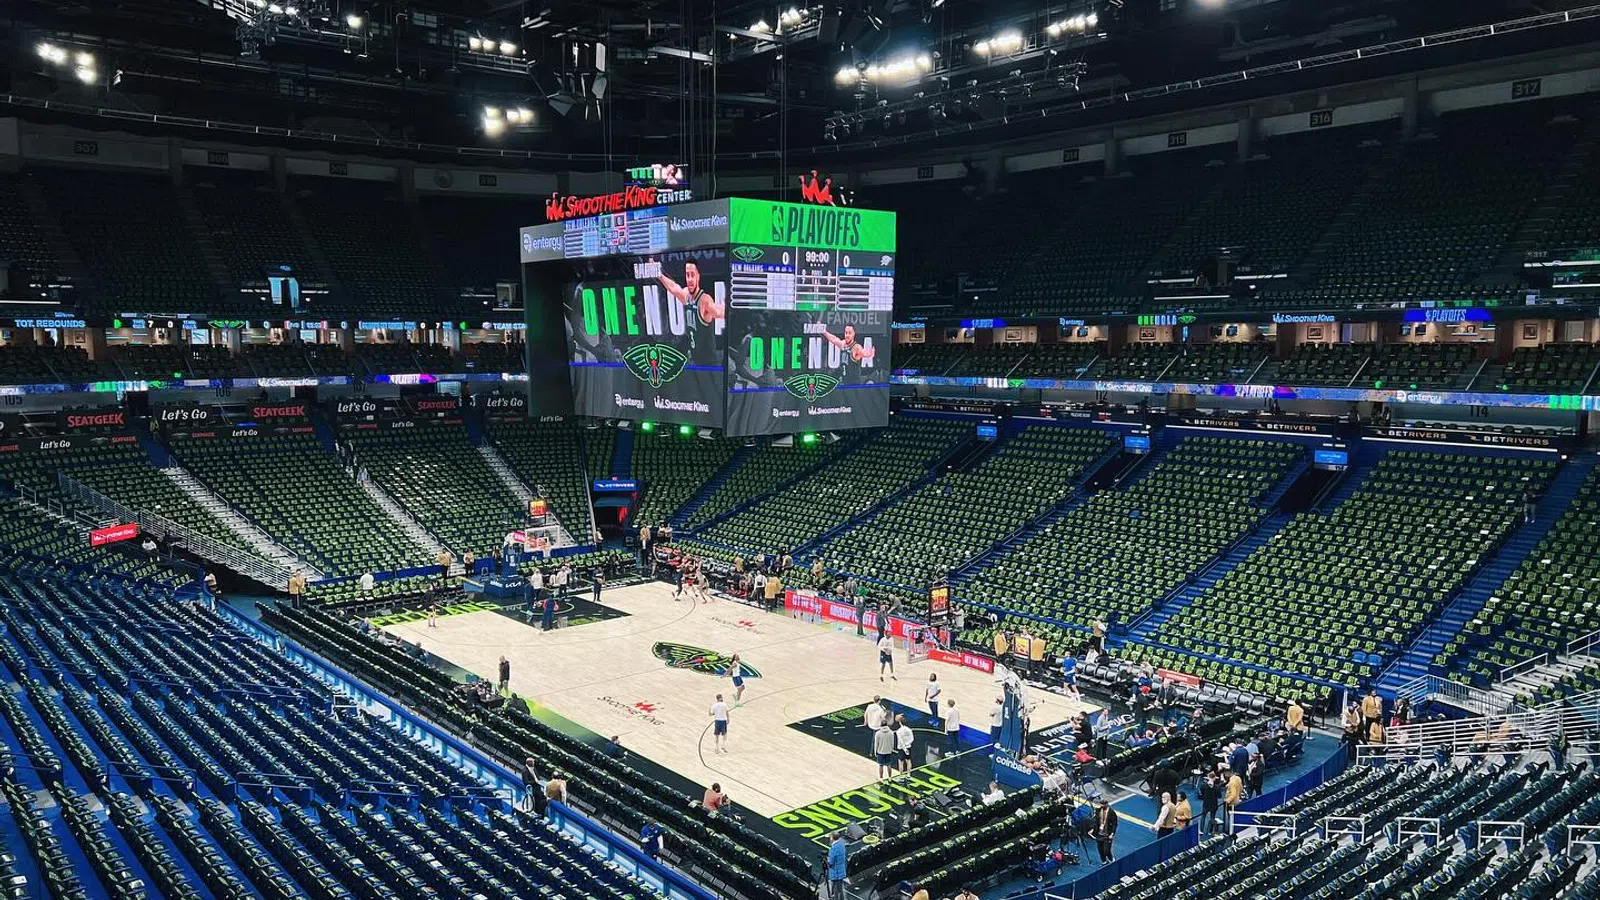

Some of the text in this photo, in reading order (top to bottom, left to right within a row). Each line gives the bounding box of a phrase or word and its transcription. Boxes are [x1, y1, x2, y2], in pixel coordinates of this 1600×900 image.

[1514, 82, 1538, 97] 317
[1311, 112, 1331, 126] 316
[1169, 133, 1185, 146] 315
[75, 142, 97, 155] 307
[565, 191, 625, 218] SMOOTHIE
[656, 189, 691, 204] CENTER
[786, 206, 861, 247] PLAYOFFS
[532, 236, 562, 251] entergy
[782, 251, 790, 265] 0
[805, 251, 830, 264] 99:00
[843, 255, 850, 268] 0
[827, 311, 881, 326] FANDUEL
[1431, 309, 1467, 322] PLAYOFFS
[15, 319, 86, 328] TOT. REBOUNDS
[148, 320, 154, 328] 7
[167, 320, 174, 328] 0
[337, 401, 376, 413] Let's Go
[486, 396, 523, 407] Let's Go
[622, 398, 645, 409] entergy
[161, 408, 208, 421] Let's Go
[253, 405, 305, 419] SEATGEEK
[1468, 404, 1489, 418] 114
[67, 412, 124, 428] SEATGEEK
[392, 420, 414, 429] Let's Go
[1194, 418, 1240, 427] BETRIVERS
[232, 429, 248, 437] Let's
[1266, 423, 1317, 432] BETRIVERS
[1388, 430, 1447, 440] BETRIVERS
[1483, 435, 1550, 447] BETRIVERS
[40, 439, 71, 450] Let's Go
[995, 755, 1032, 776] coinbase
[772, 767, 962, 839] PELICANS
